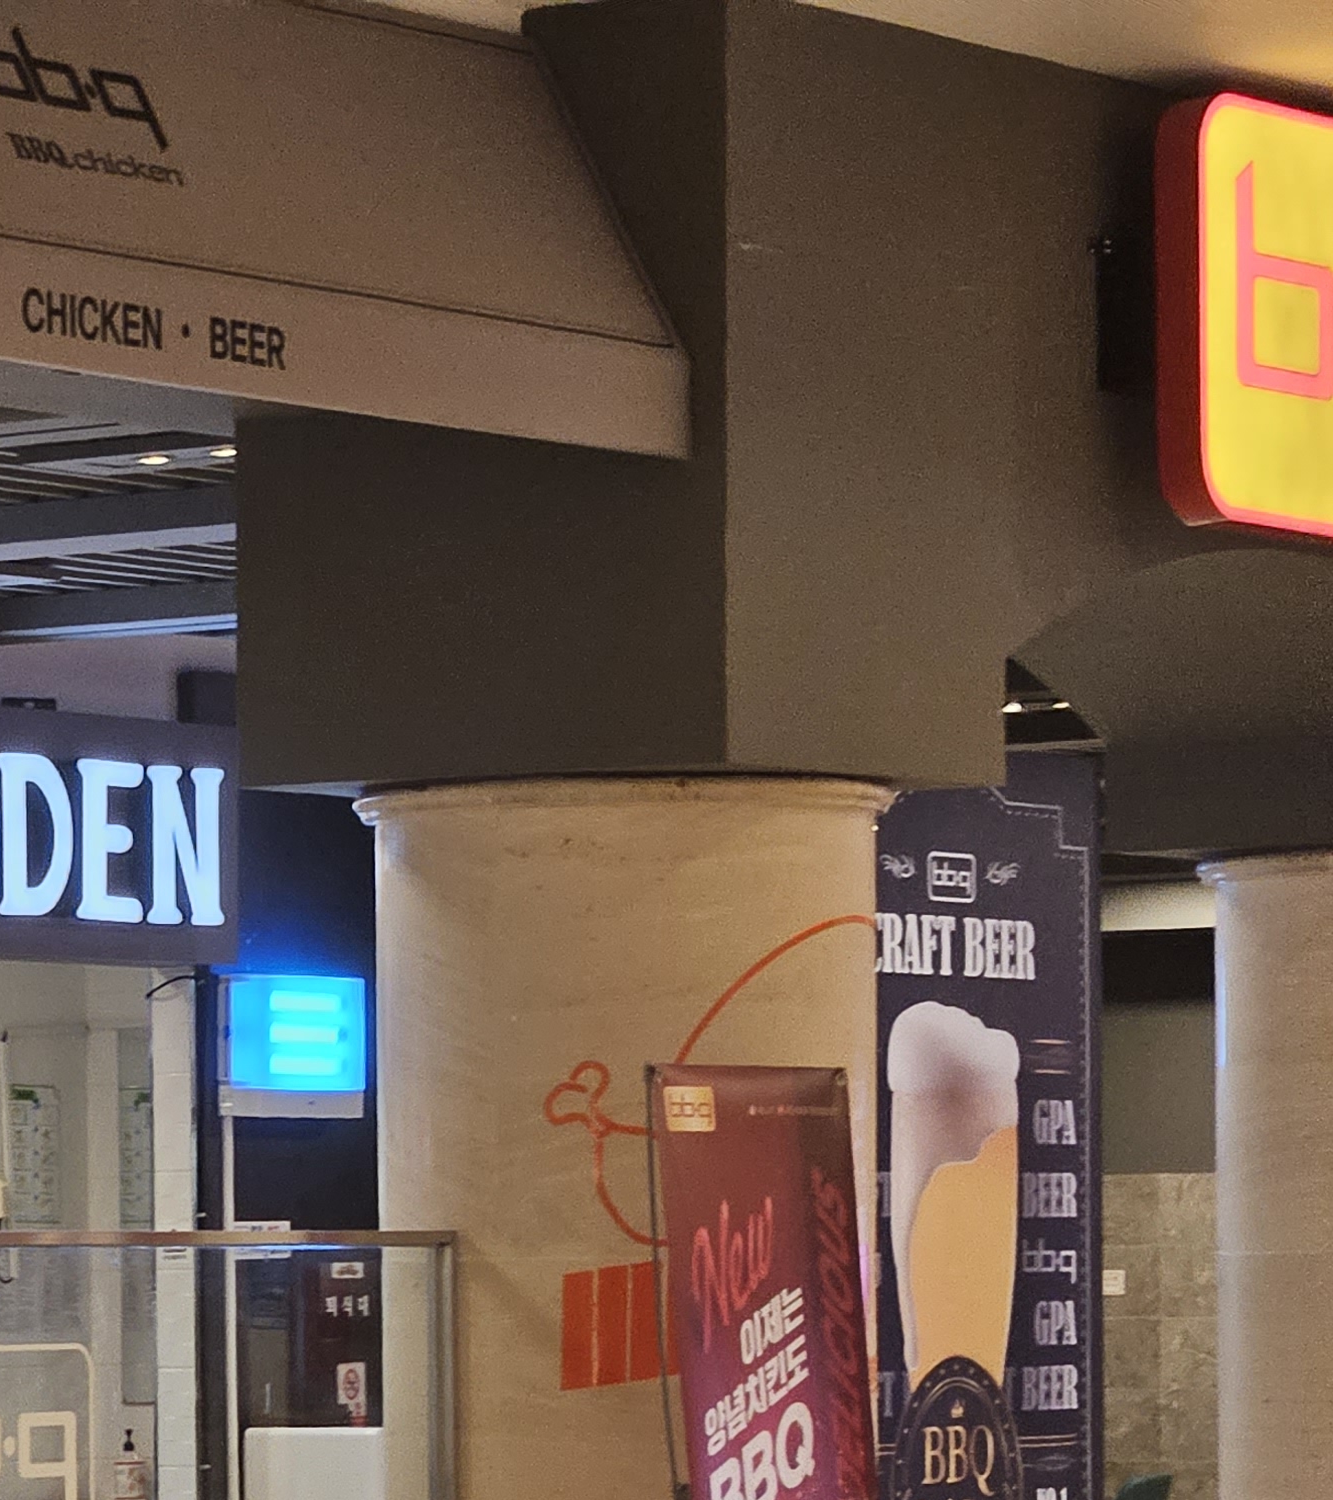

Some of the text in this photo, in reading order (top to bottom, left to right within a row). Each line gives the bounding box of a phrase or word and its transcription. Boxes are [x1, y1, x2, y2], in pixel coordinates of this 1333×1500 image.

[21, 287, 286, 370] CHICKEN BEER
[963, 917, 1036, 980] BEER
[1022, 1172, 1077, 1218] BEER
[740, 1287, 804, 1365] 이제는
[704, 1334, 810, 1456] 양념치킨도
[1021, 1364, 1079, 1411] BEER
[922, 1425, 995, 1497] BBQ
